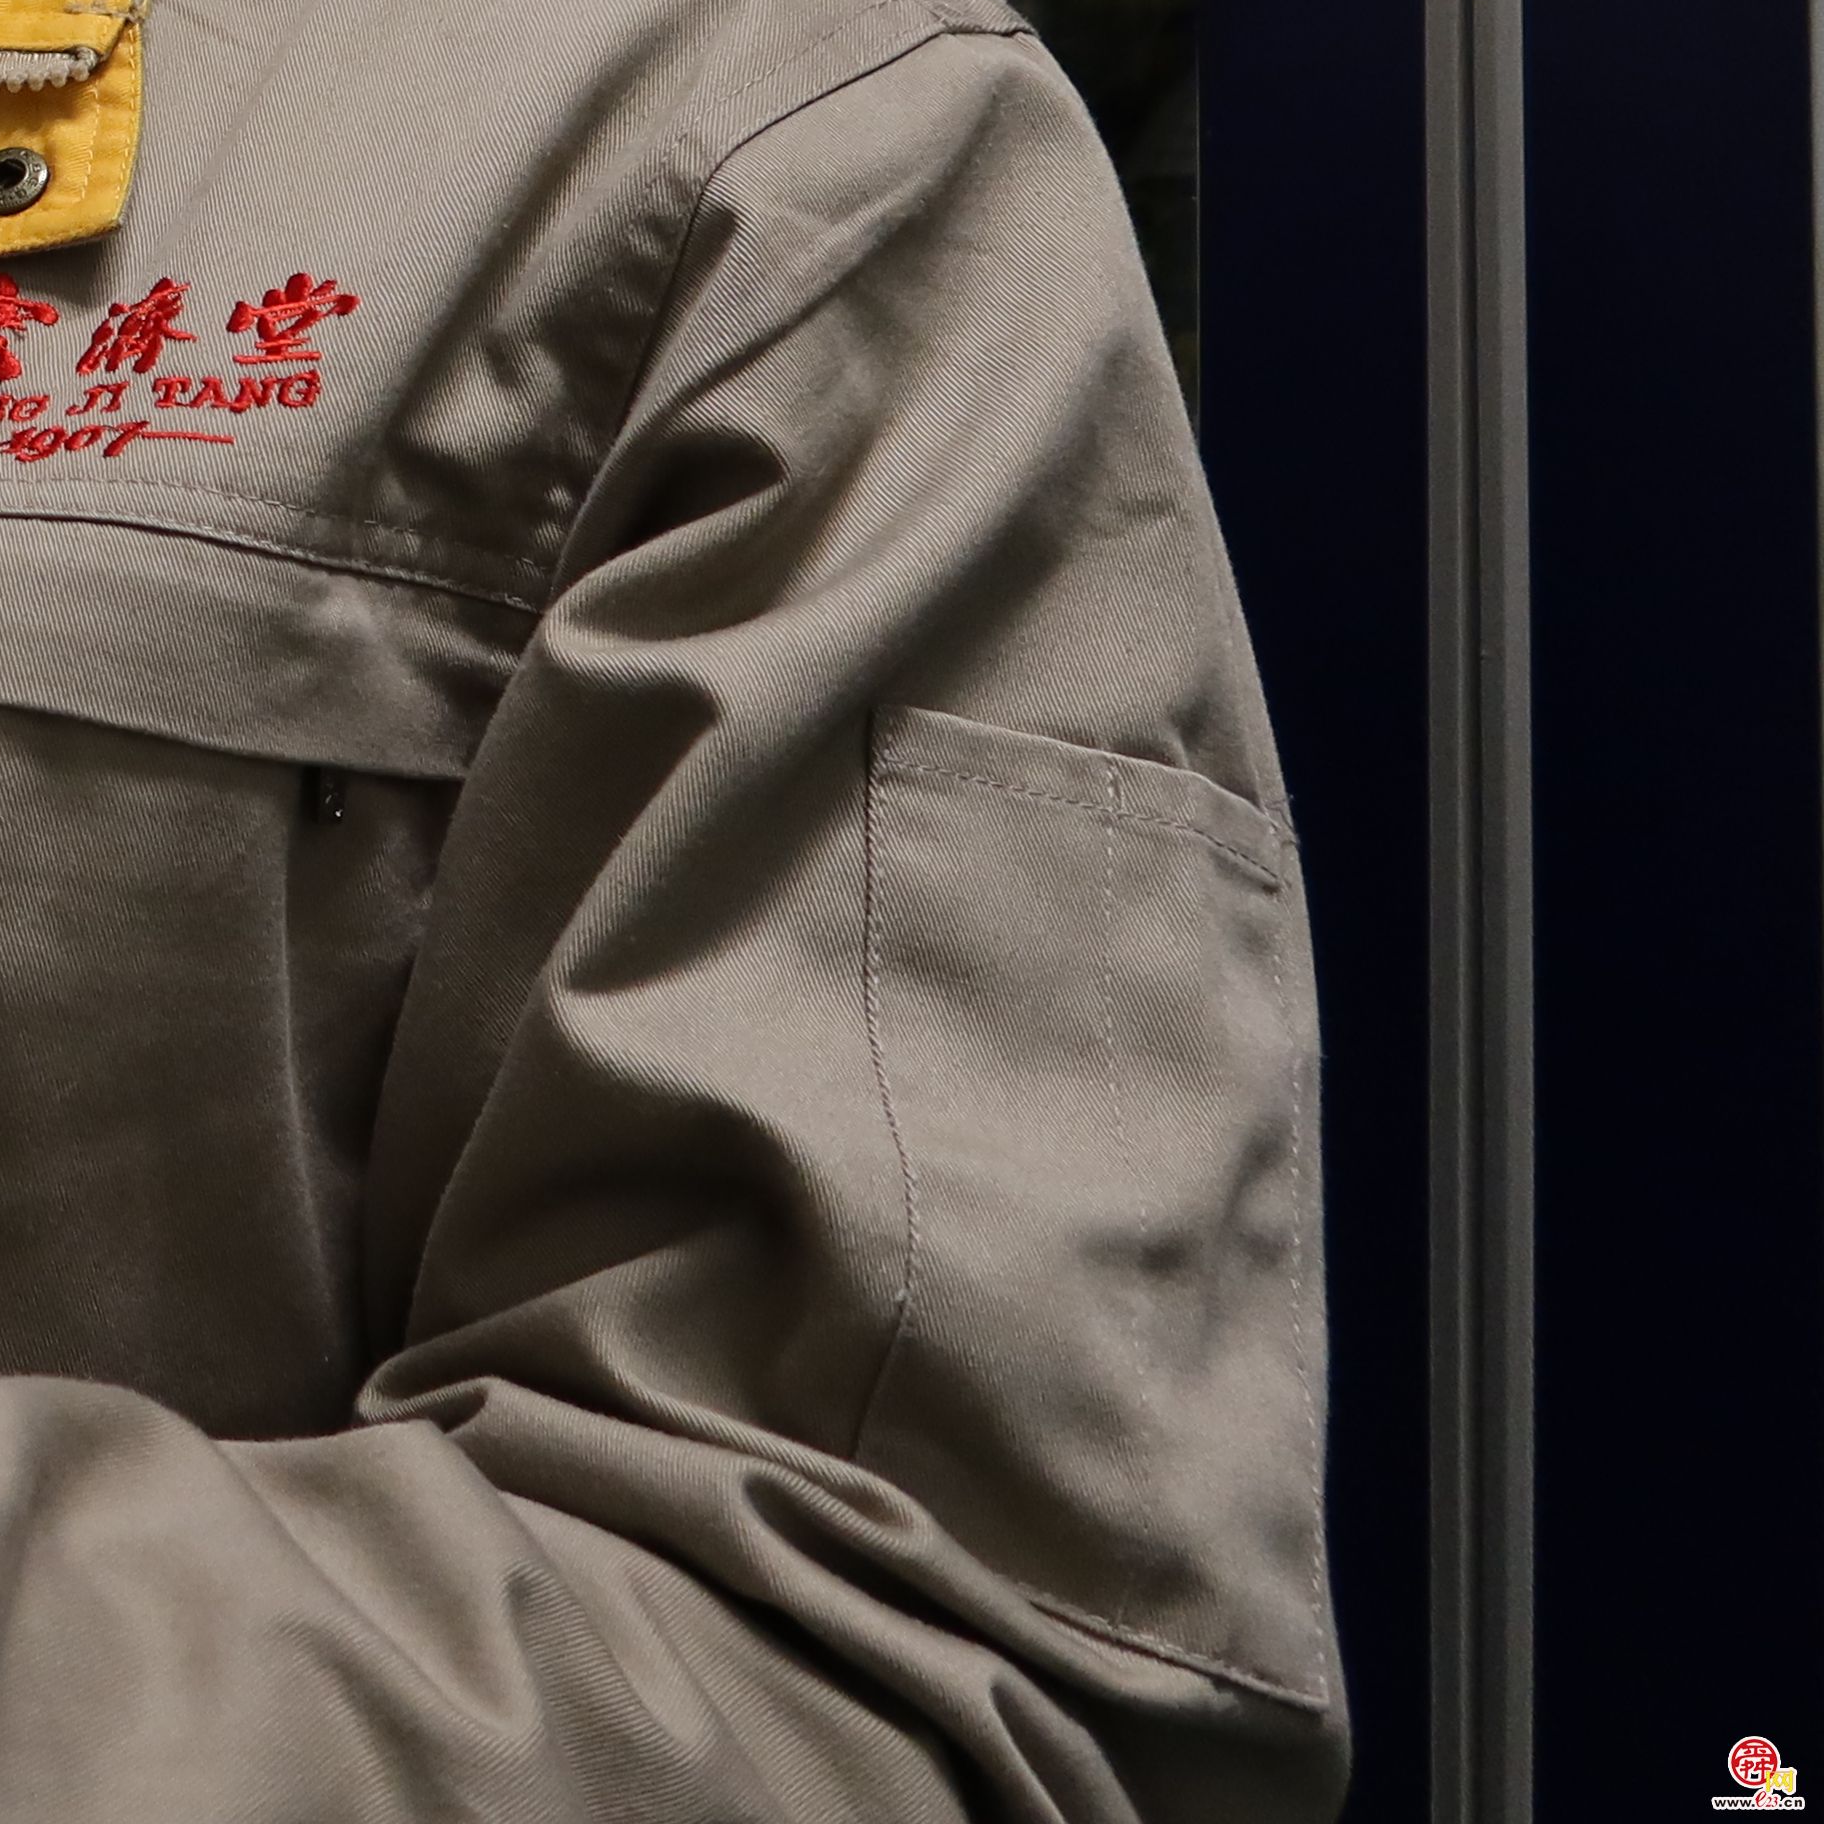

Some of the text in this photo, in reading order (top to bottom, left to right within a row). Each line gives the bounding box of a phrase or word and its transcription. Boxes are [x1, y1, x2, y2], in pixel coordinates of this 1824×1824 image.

[66, 381, 130, 416] JI
[153, 369, 321, 414] TANG
[5, 420, 151, 463] 1907
